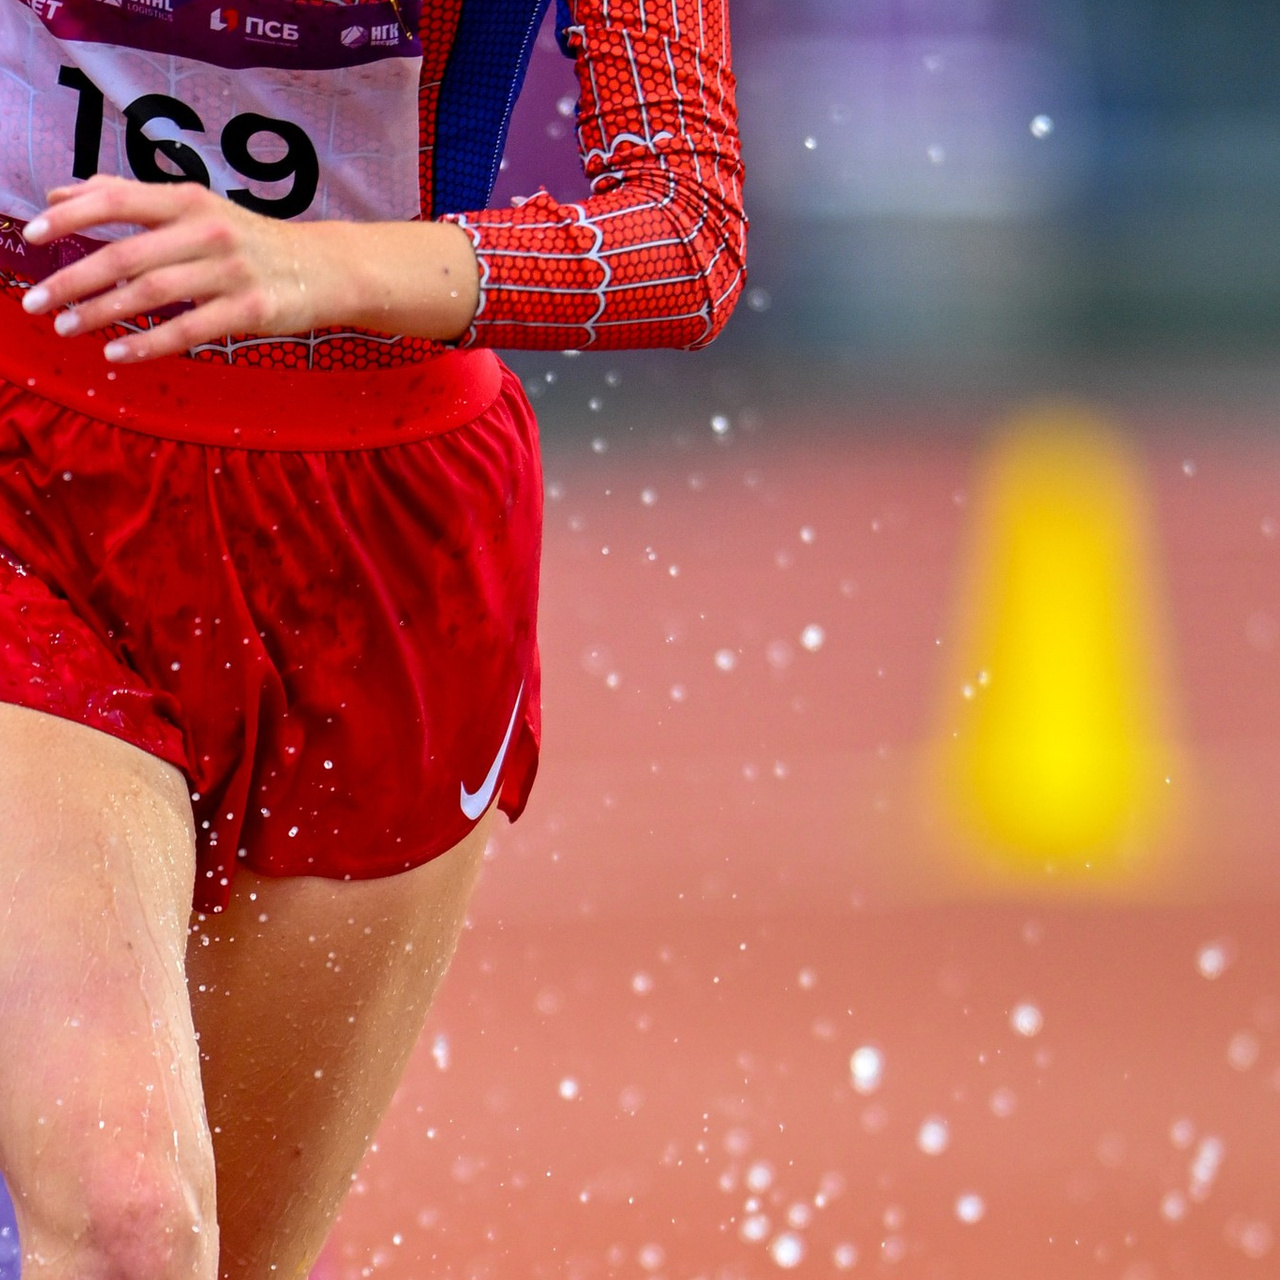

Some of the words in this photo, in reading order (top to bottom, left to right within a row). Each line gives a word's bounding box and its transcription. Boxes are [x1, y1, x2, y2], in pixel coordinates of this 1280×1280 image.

[127, 2, 174, 23] LOGISTICS
[245, 16, 299, 41] ПСБ
[370, 22, 399, 40] НГК
[57, 65, 320, 220] 169
